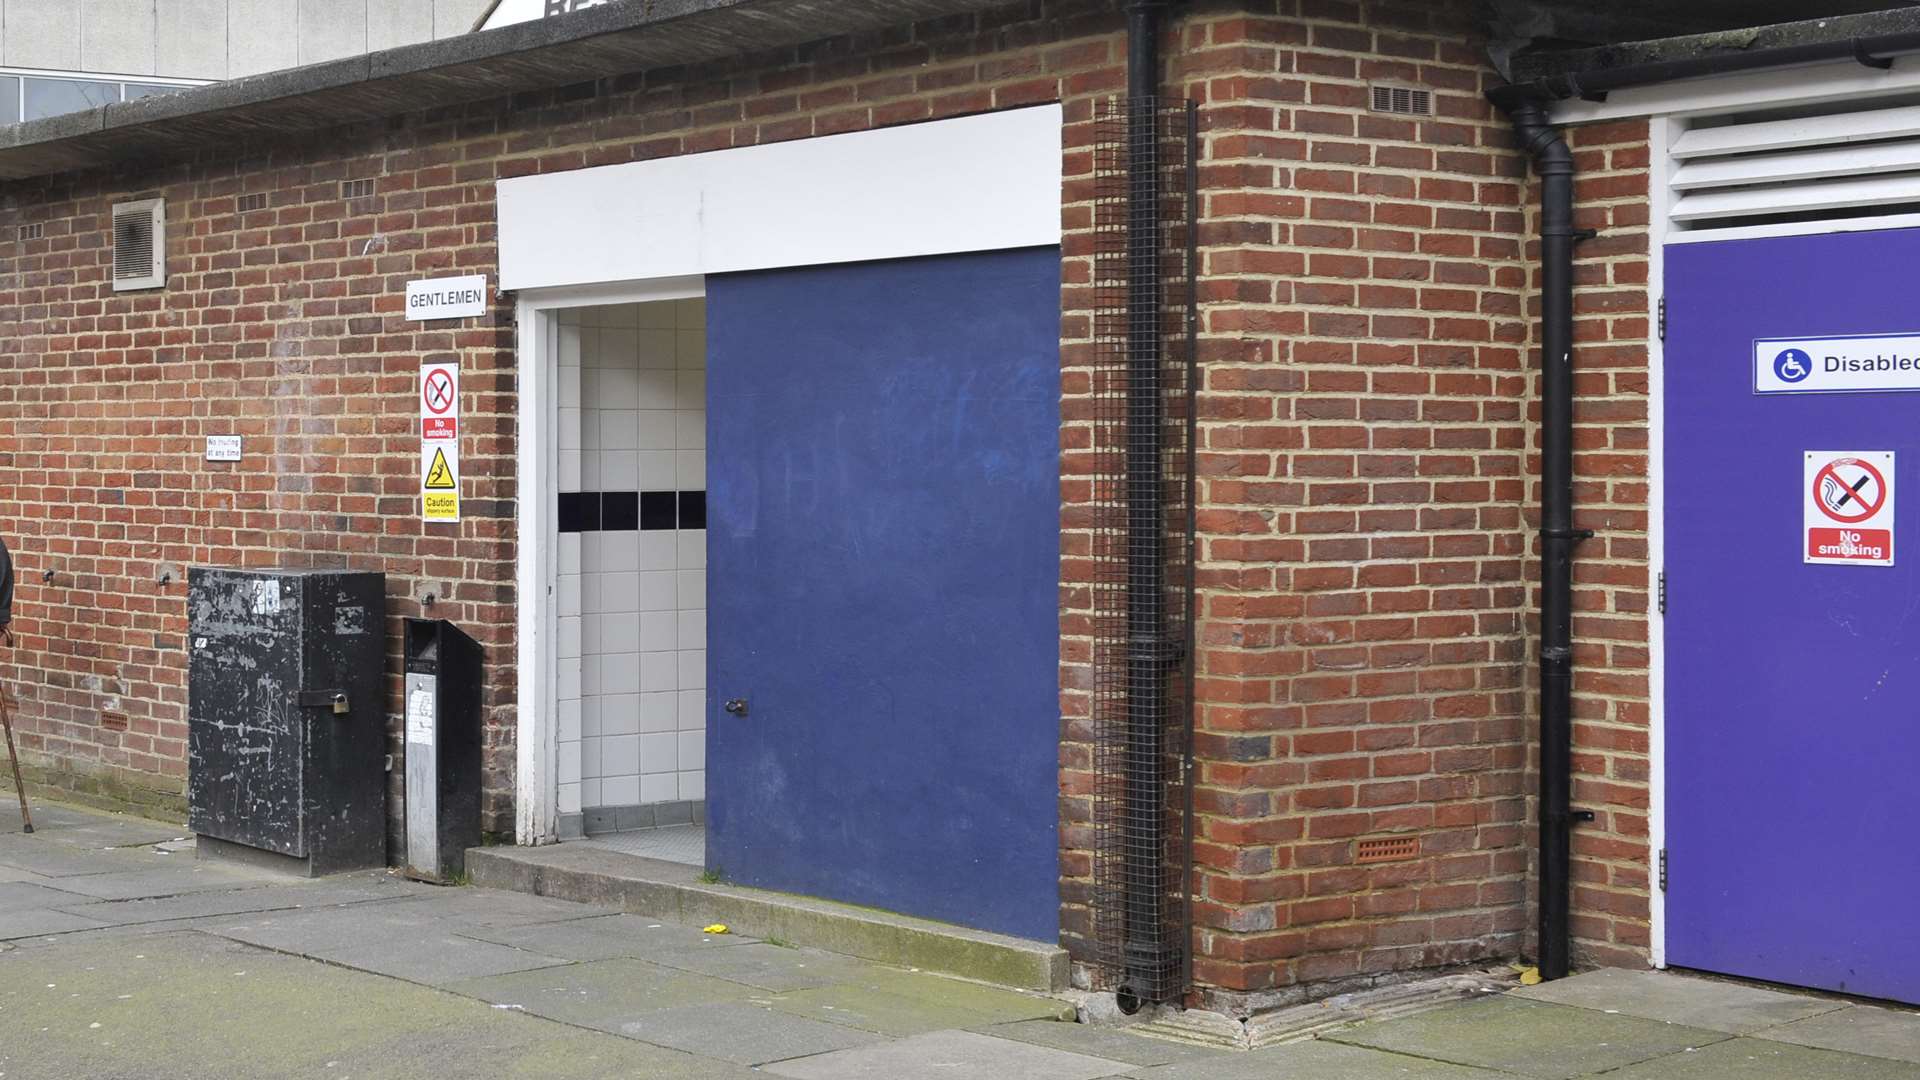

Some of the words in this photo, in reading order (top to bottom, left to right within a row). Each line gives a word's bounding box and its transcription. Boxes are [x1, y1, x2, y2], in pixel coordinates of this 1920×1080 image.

[410, 289, 482, 308] GENTLEMEN
[435, 419, 445, 428] No
[426, 428, 453, 437] smoking
[426, 497, 455, 507] Caution
[1840, 530, 1861, 542] No
[1818, 544, 1882, 558] smoking
